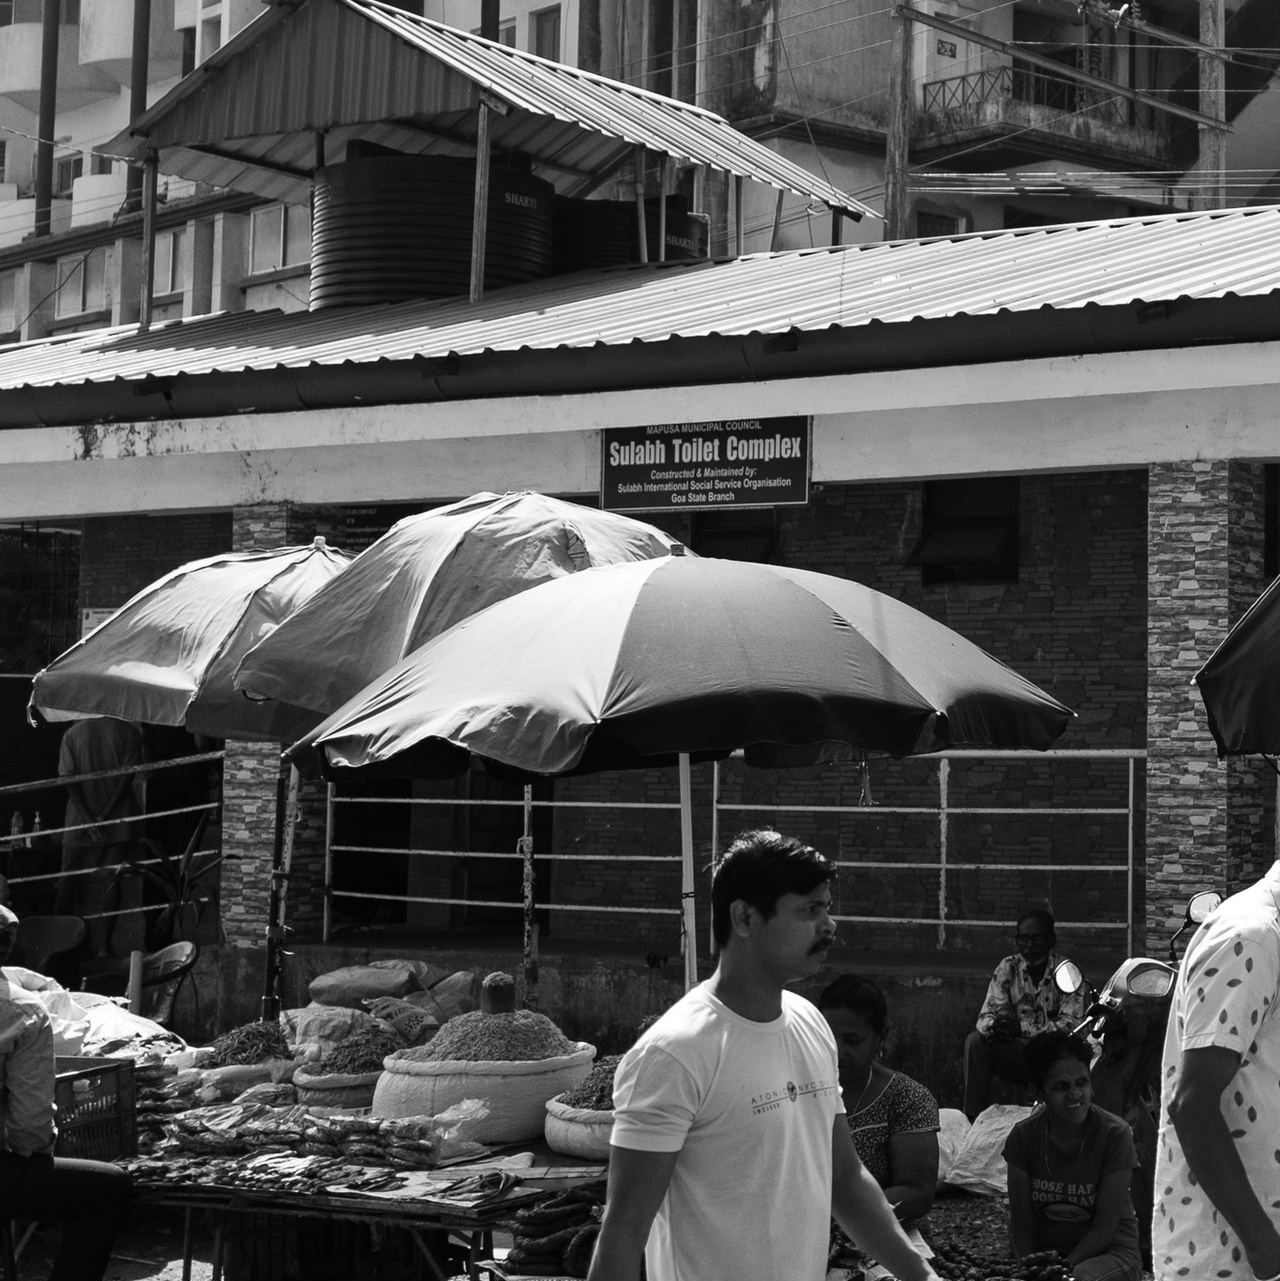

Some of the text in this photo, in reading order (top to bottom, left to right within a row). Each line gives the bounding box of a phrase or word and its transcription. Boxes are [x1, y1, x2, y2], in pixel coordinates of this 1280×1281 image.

[504, 192, 537, 210] SHAKTI
[666, 234, 694, 251] SHAKTI
[647, 420, 762, 435] MAPUSA MUNICIPAL COUNCIL
[610, 434, 801, 466] Sulabh Toilet Complex
[650, 466, 757, 480] Constructed & Maintained by:
[618, 477, 791, 493] Sulabh International Social Service Organisation
[671, 491, 735, 503] Goa State Branch
[751, 1087, 788, 1105] ATONIC
[1067, 1183, 1094, 1195] HAP
[1068, 1194, 1096, 1207] HAP
